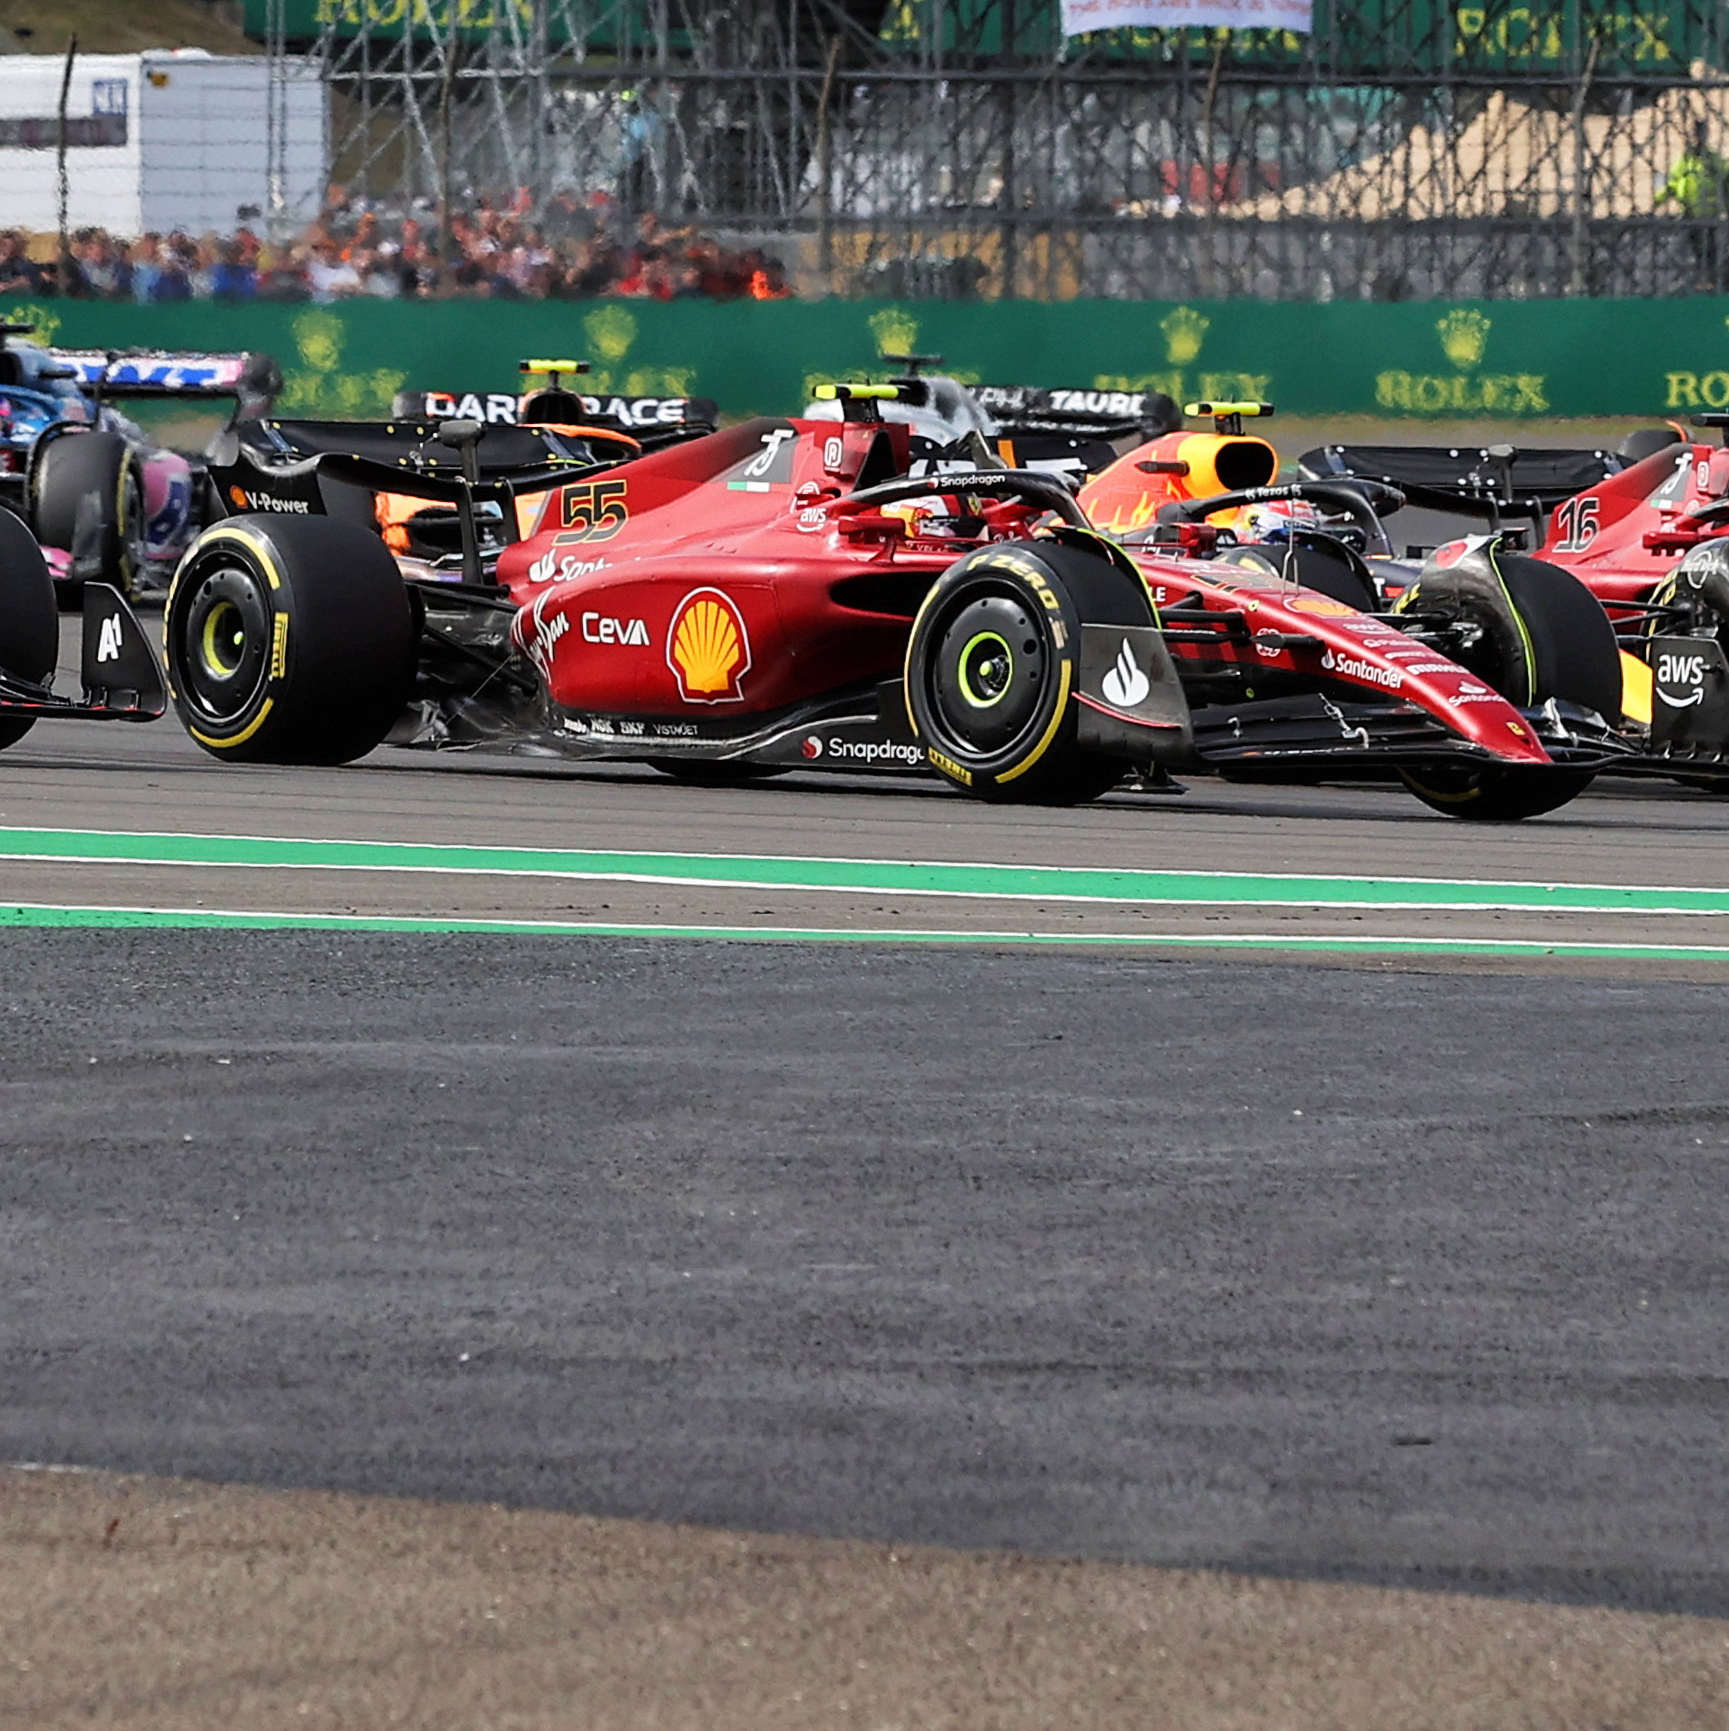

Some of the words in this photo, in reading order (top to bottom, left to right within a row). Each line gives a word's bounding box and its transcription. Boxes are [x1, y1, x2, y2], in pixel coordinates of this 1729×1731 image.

[1456, 7, 1669, 60] ROLX
[1376, 370, 1549, 411] ROLEX
[425, 392, 688, 426] DARACE
[940, 474, 1006, 488] Snapdragon
[245, 490, 309, 514] V-Power
[552, 479, 628, 546] 55
[800, 507, 827, 523] aws
[1553, 497, 1601, 554] 16
[988, 554, 1060, 610] ZERO
[1335, 652, 1405, 690] Santander
[1657, 654, 1704, 685] aws
[829, 738, 924, 765] Snapdrag
